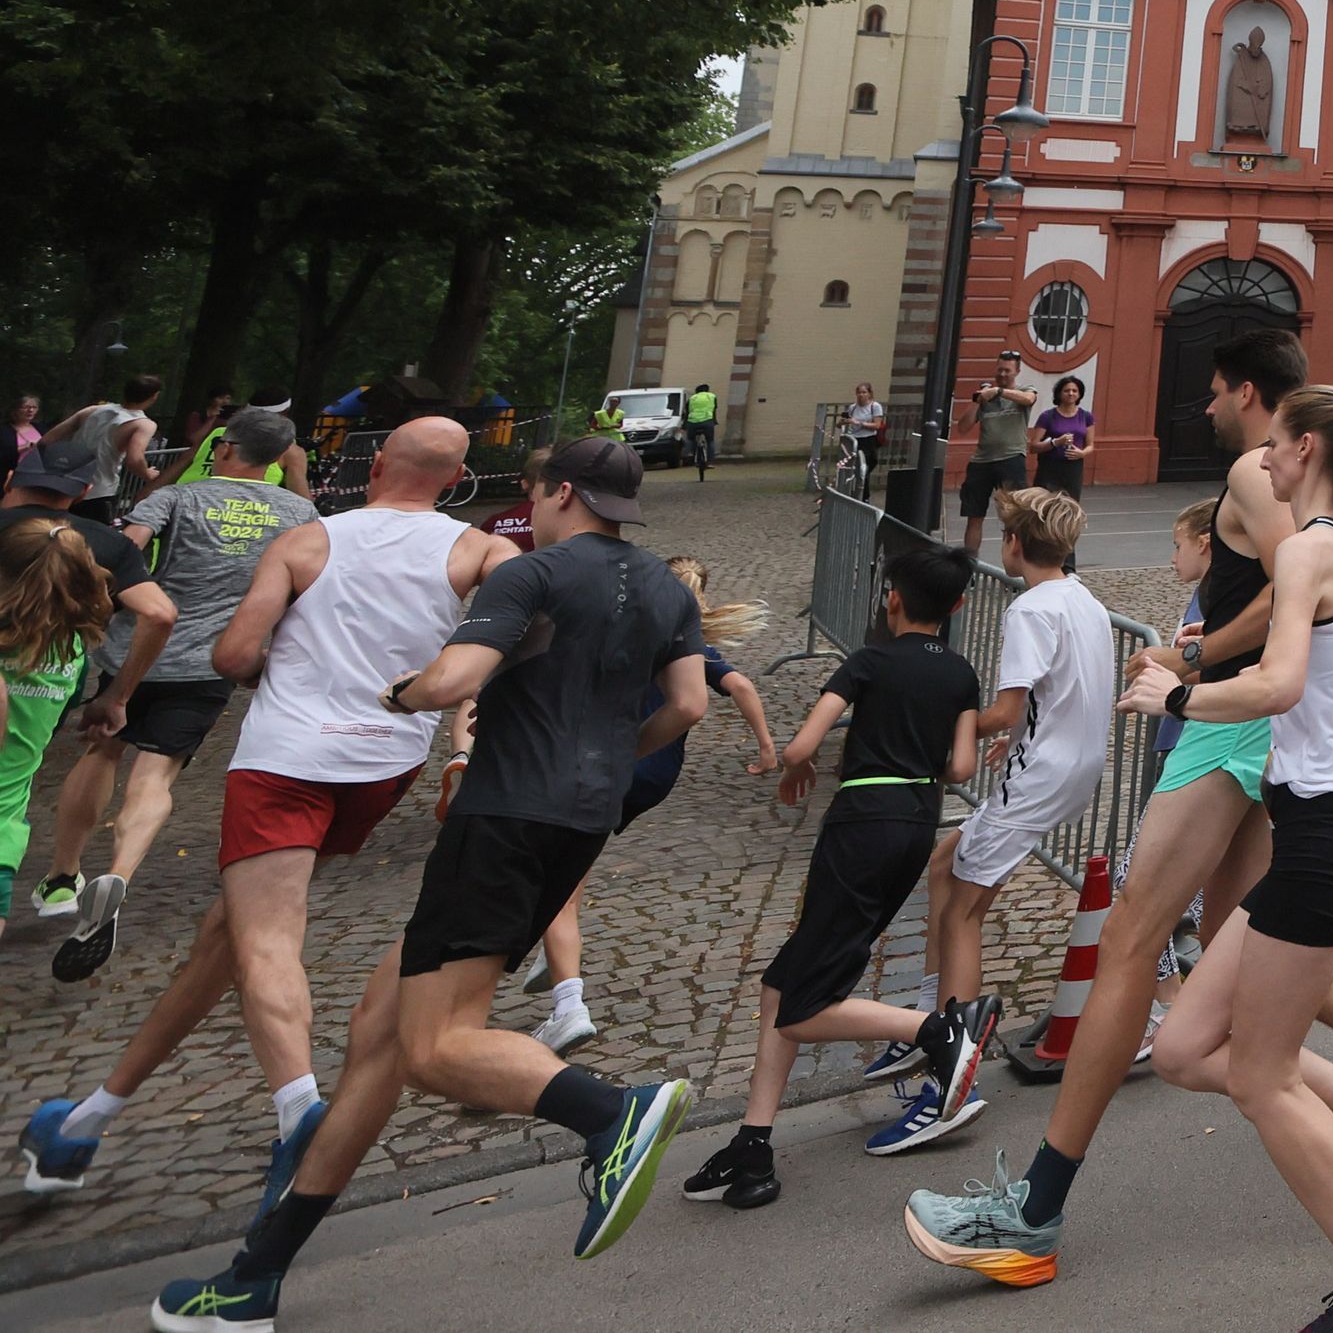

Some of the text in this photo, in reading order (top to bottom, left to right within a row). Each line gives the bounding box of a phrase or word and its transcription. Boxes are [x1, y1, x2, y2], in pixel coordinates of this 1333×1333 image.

[223, 498, 270, 514] TEAM
[205, 507, 281, 527] ENERGIE
[494, 517, 528, 528] ASV
[218, 524, 264, 539] 2024
